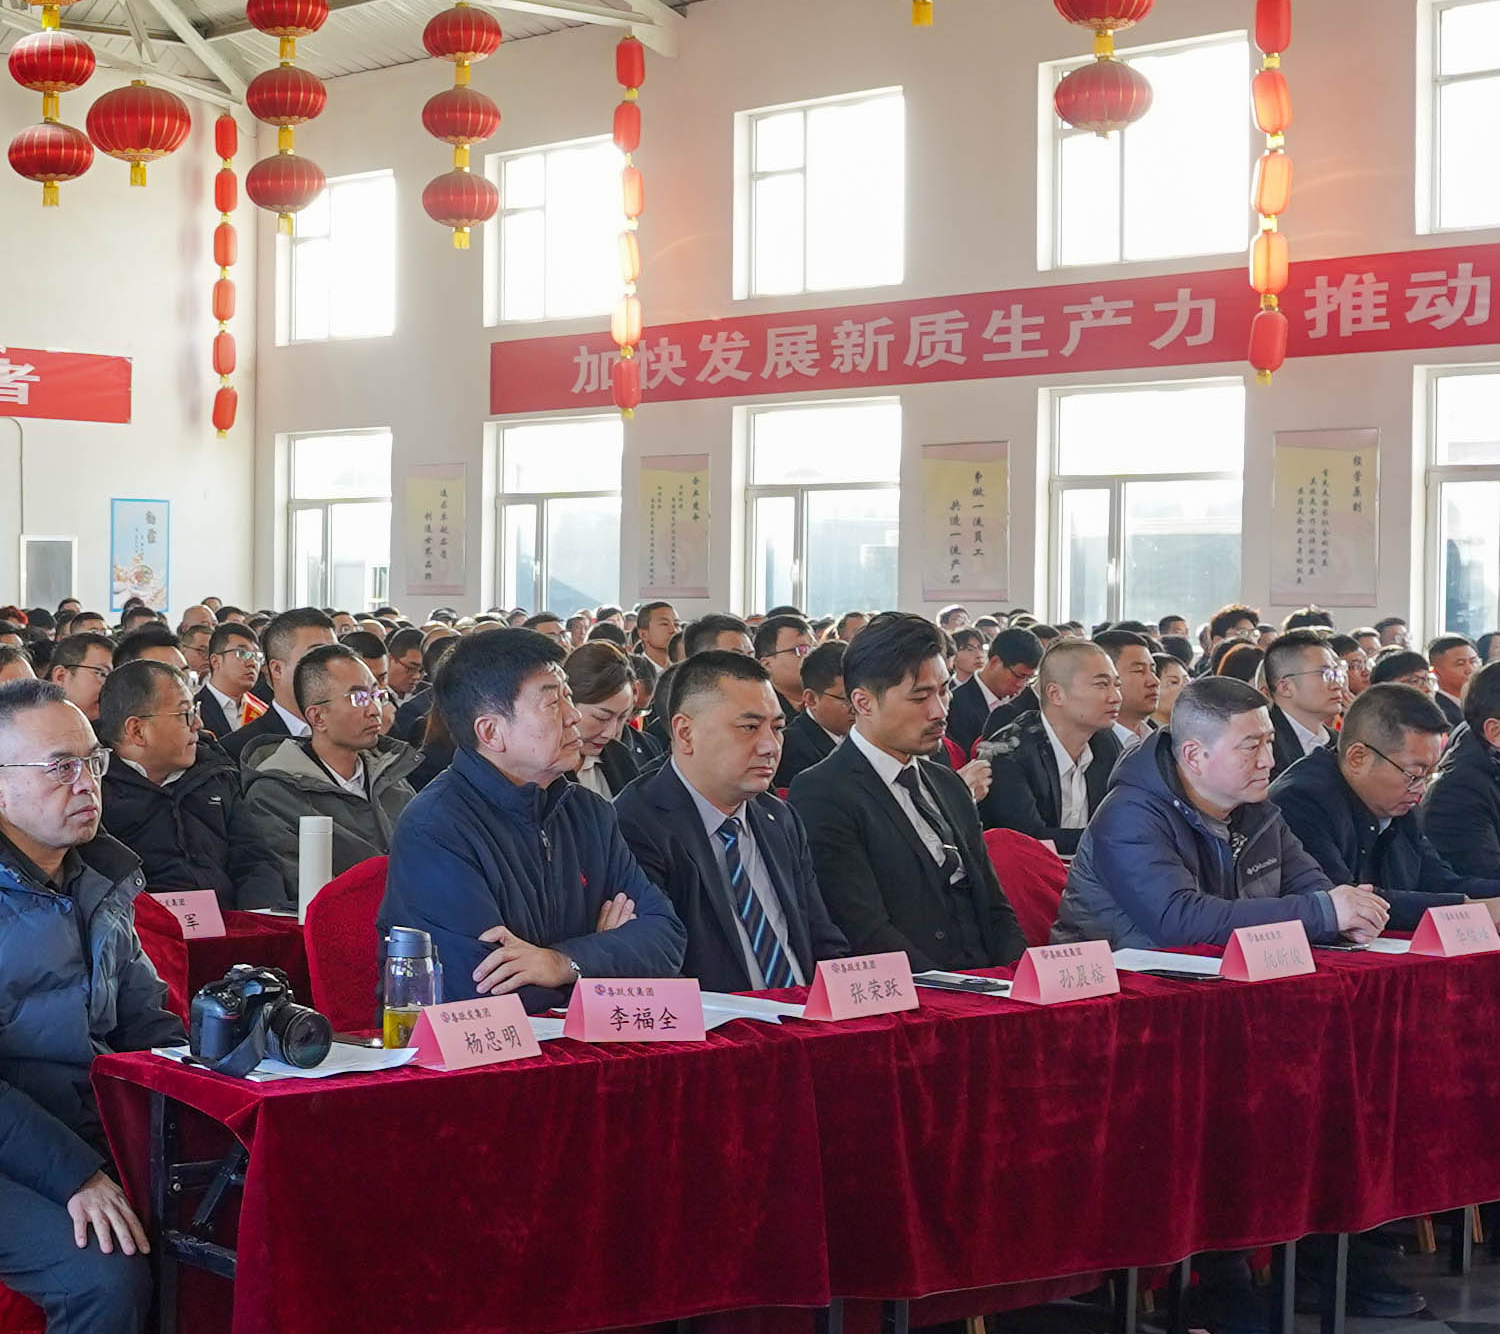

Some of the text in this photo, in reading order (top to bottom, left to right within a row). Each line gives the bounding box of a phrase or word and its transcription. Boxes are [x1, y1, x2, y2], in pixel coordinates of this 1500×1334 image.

[571, 287, 1217, 394] 加快发展新质生产力
[849, 977, 903, 1004] 张荣跃
[609, 1005, 679, 1032] 李福全
[463, 1024, 522, 1056] 杨忠明
